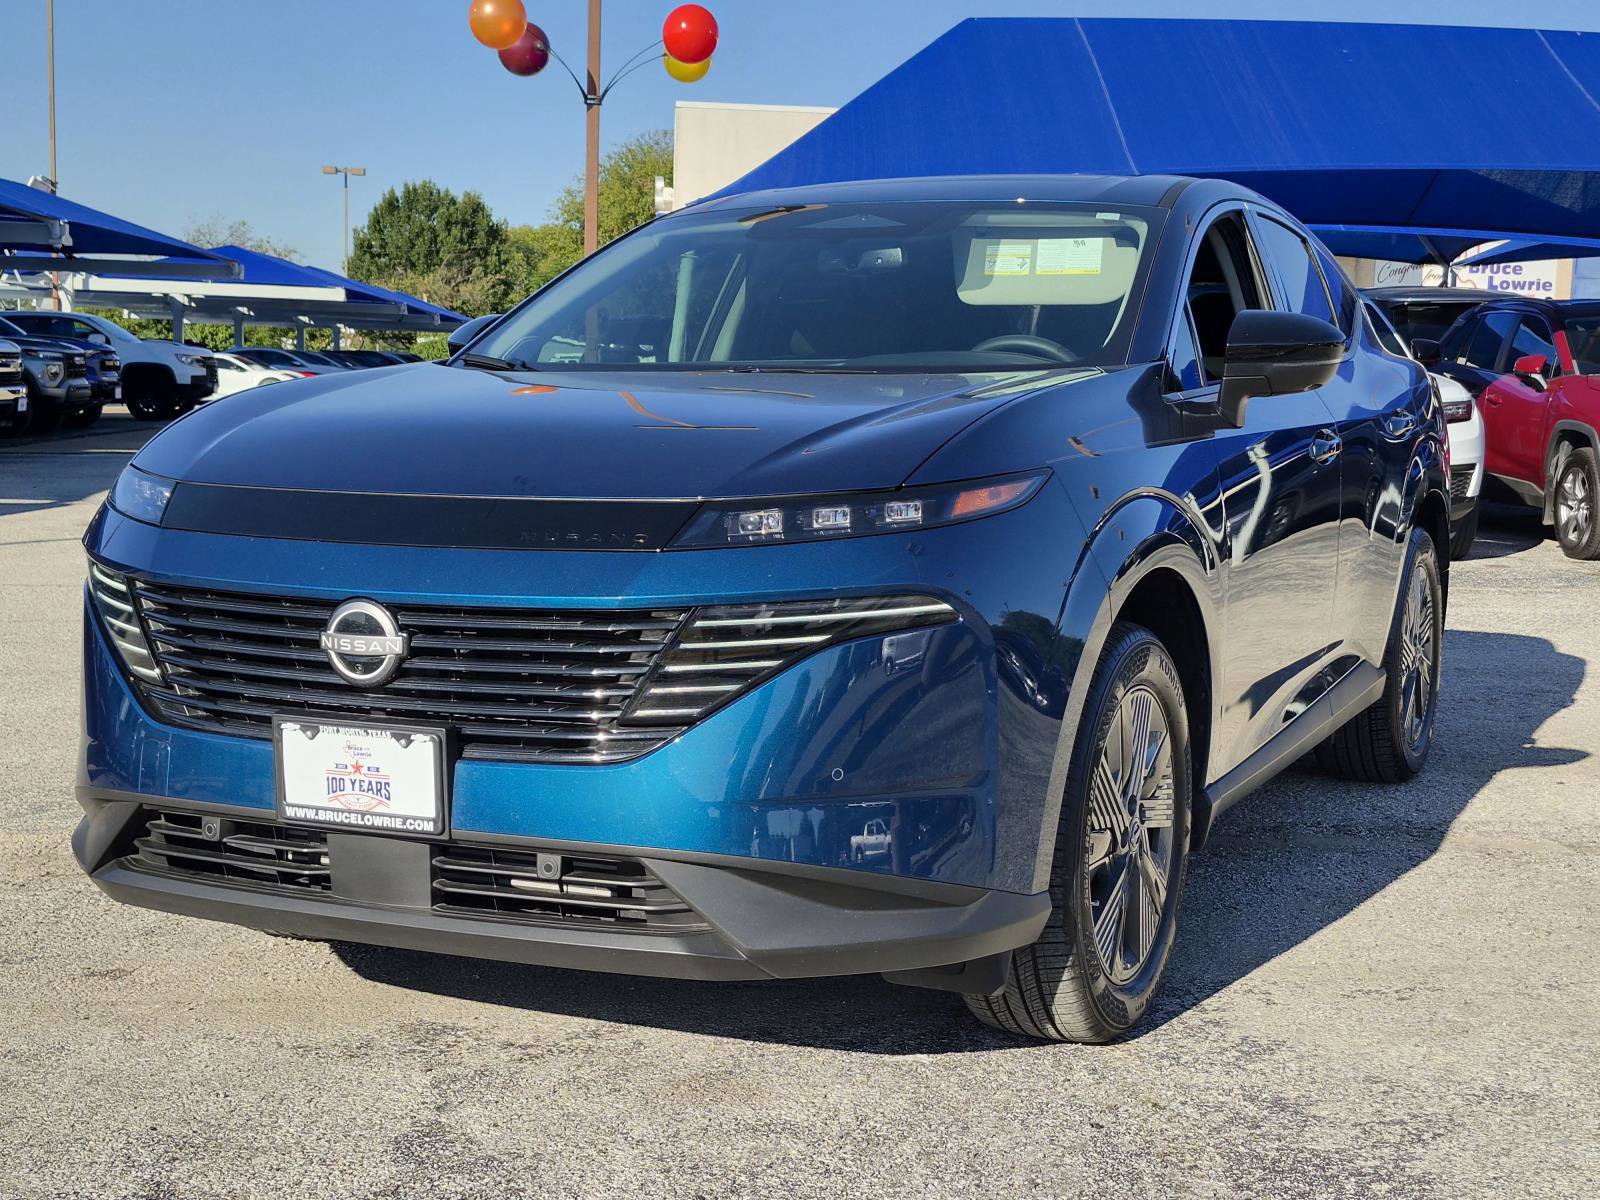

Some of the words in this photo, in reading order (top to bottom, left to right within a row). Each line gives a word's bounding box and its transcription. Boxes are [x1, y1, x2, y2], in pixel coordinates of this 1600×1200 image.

[1487, 275, 1553, 292] Lowrie
[321, 635, 400, 653] NISSAN
[326, 775, 345, 795] 100
[349, 777, 391, 801] YEARS
[285, 806, 434, 831] WWW.BRUCELOWRIE.COM
